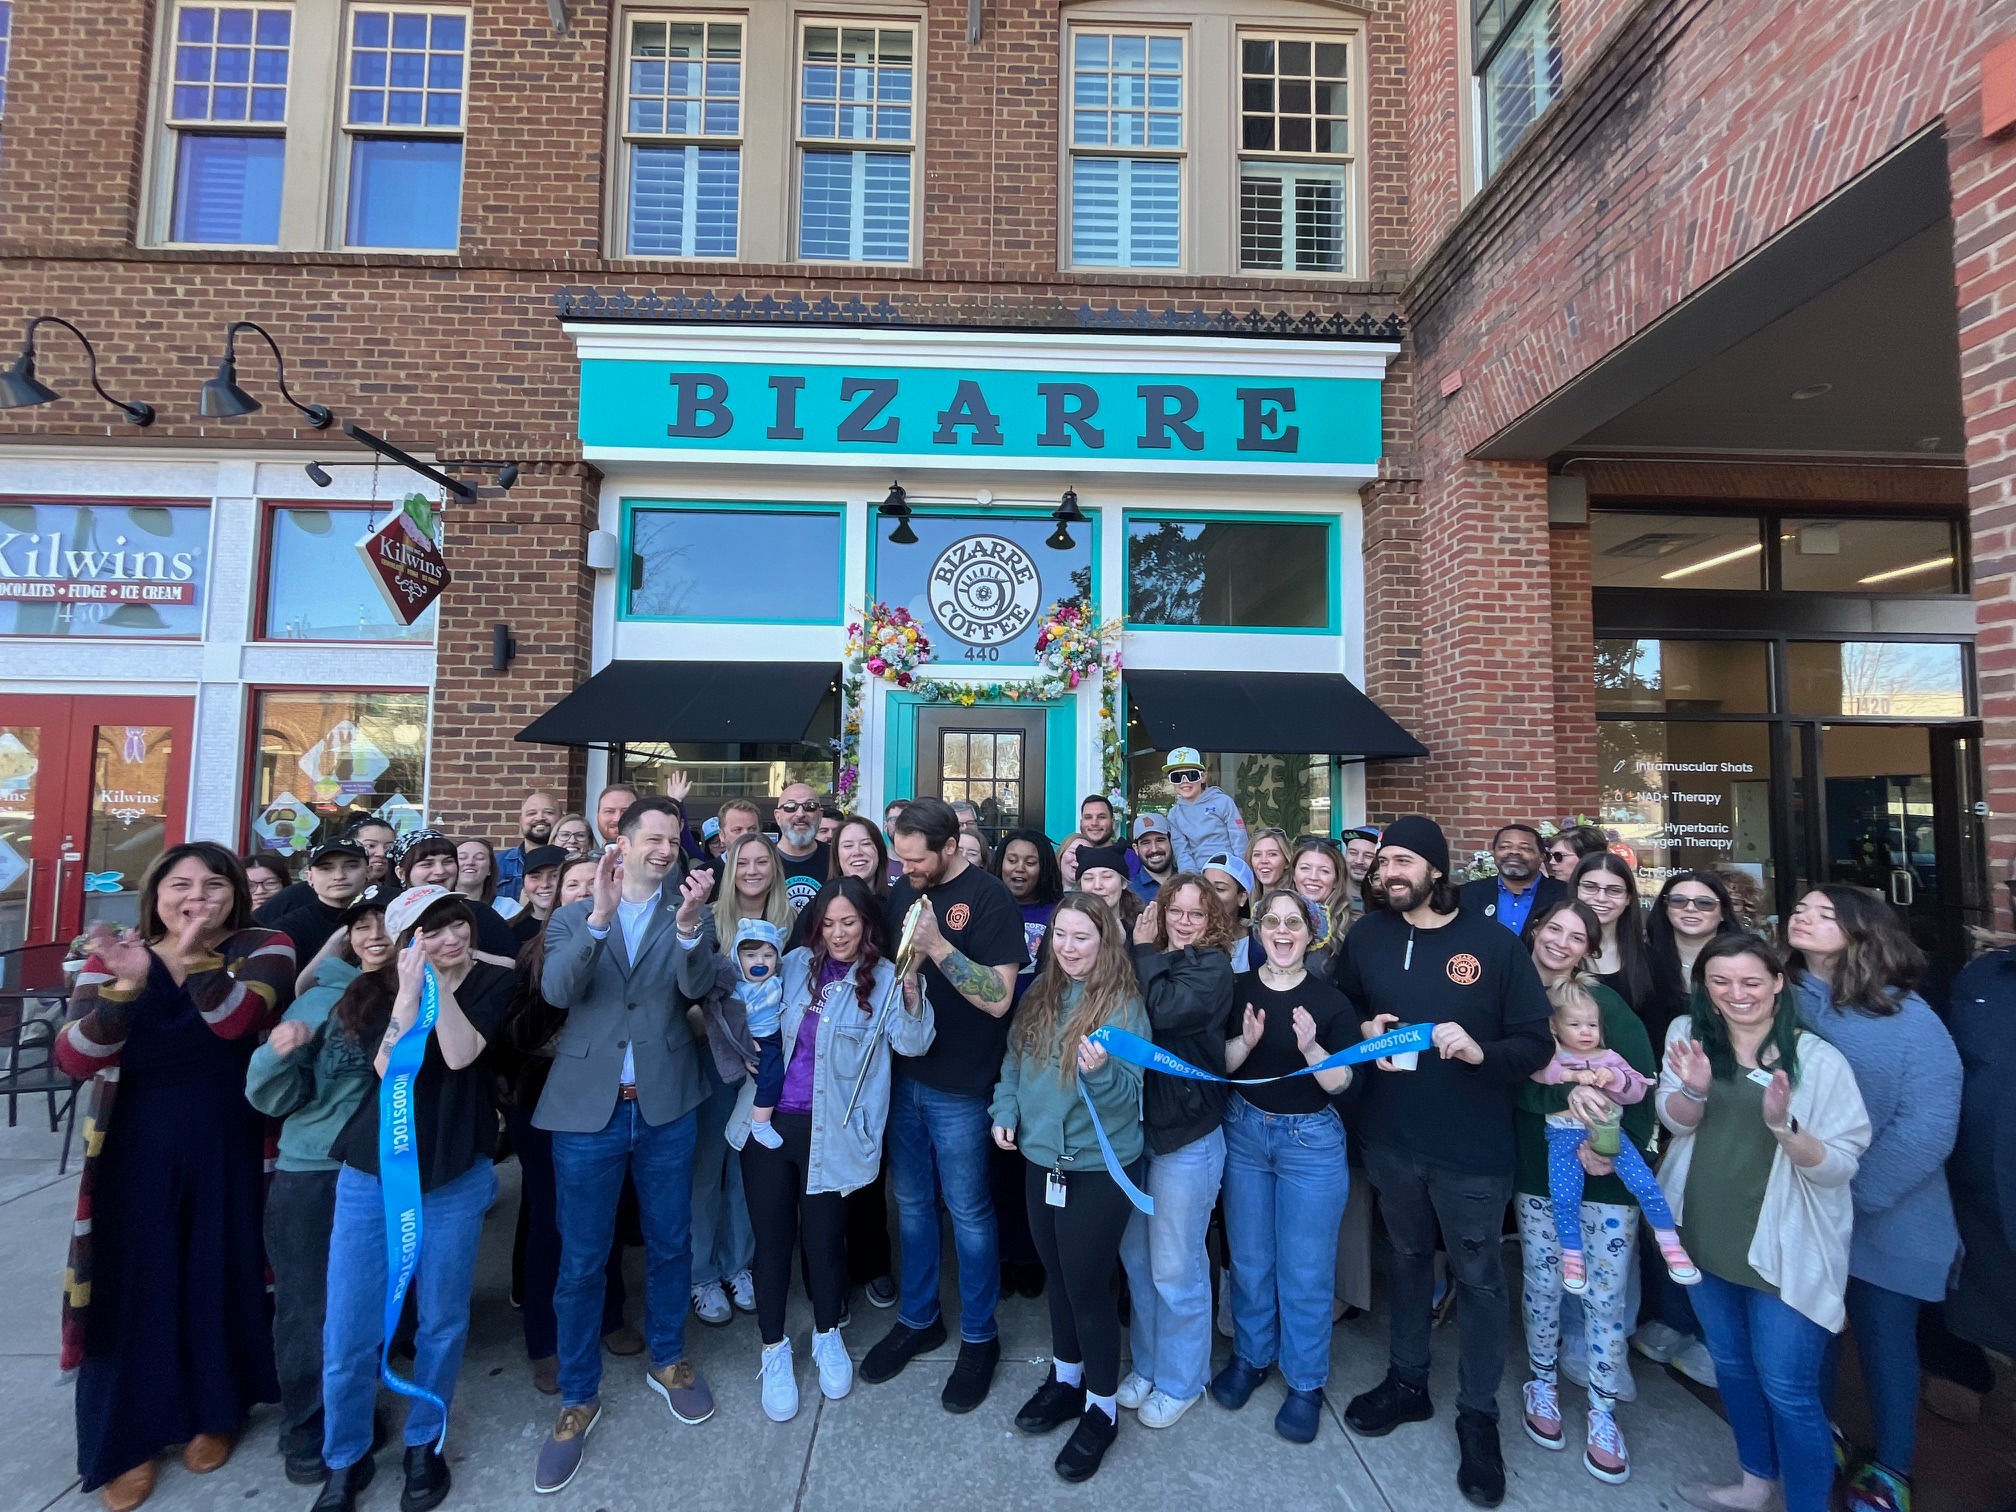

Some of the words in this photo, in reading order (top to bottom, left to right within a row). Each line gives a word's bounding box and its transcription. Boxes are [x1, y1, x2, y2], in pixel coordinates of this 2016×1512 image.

[667, 373, 1300, 453] BIZARRE
[0, 532, 193, 581] Kilwins
[380, 535, 442, 579] Kilwins
[934, 541, 1034, 586] BIZARRE
[0, 582, 56, 597] OCOLATES
[68, 584, 107, 599] FUDGE
[120, 585, 139, 599] ICE
[142, 586, 182, 600] CREAM
[938, 600, 1031, 640] COFFEE
[965, 647, 999, 661] 440
[1636, 762, 1718, 772] Intramuscular
[1720, 762, 1753, 773] Shots
[101, 789, 159, 803] Kilwins
[1637, 792, 1669, 802] NAD+
[1672, 791, 1721, 806] Therapy
[1664, 823, 1729, 835] Hyperbaric
[1685, 837, 1733, 850] Therapy
[1360, 1029, 1421, 1054] WOODSTOCK
[392, 1072, 411, 1156] WOODSTOCK
[392, 1208, 417, 1304] WOODSTOCK
